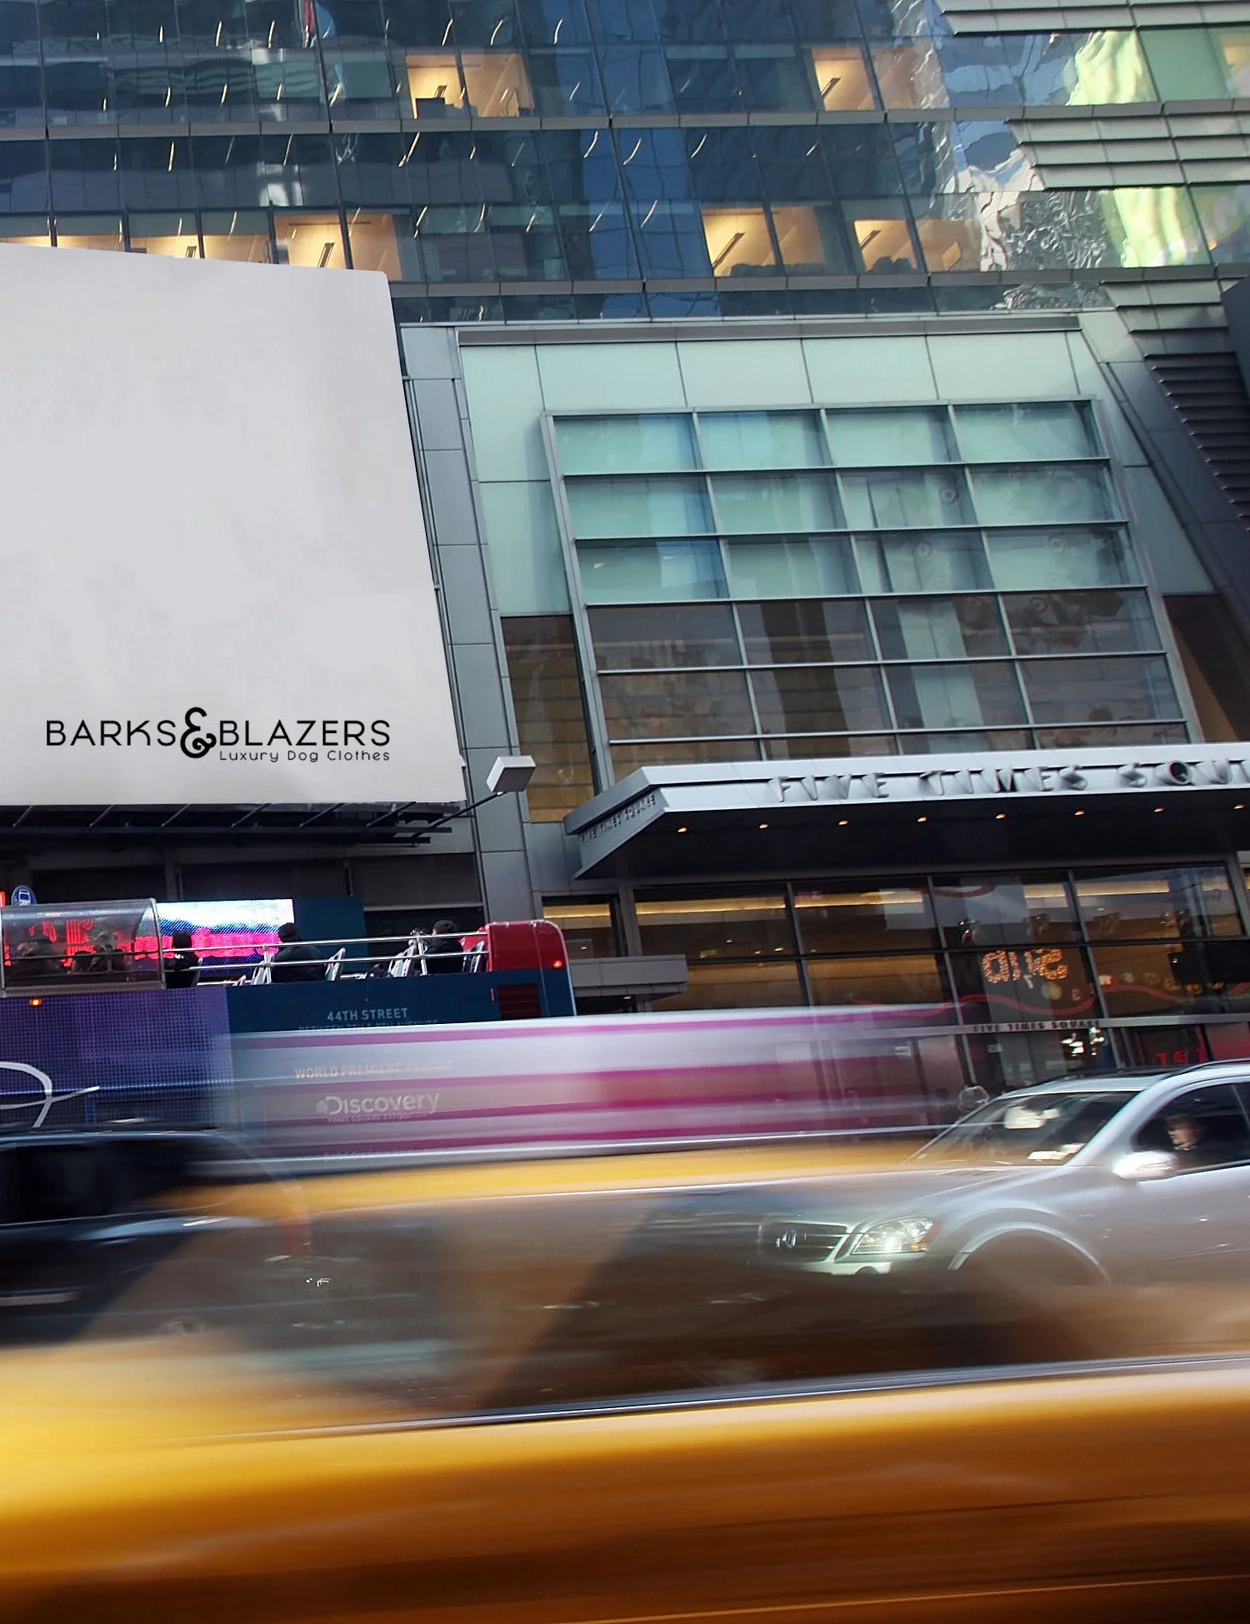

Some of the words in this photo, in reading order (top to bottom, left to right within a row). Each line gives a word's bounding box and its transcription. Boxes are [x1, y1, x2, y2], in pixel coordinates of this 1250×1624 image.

[219, 749, 280, 762] Luxury
[287, 749, 319, 762] Dog
[327, 749, 391, 761] Clothes
[1117, 756, 1250, 789] SQU
[326, 1010, 359, 1022] 44TH
[361, 1007, 409, 1021] STREET
[294, 1064, 339, 1080] WORLD
